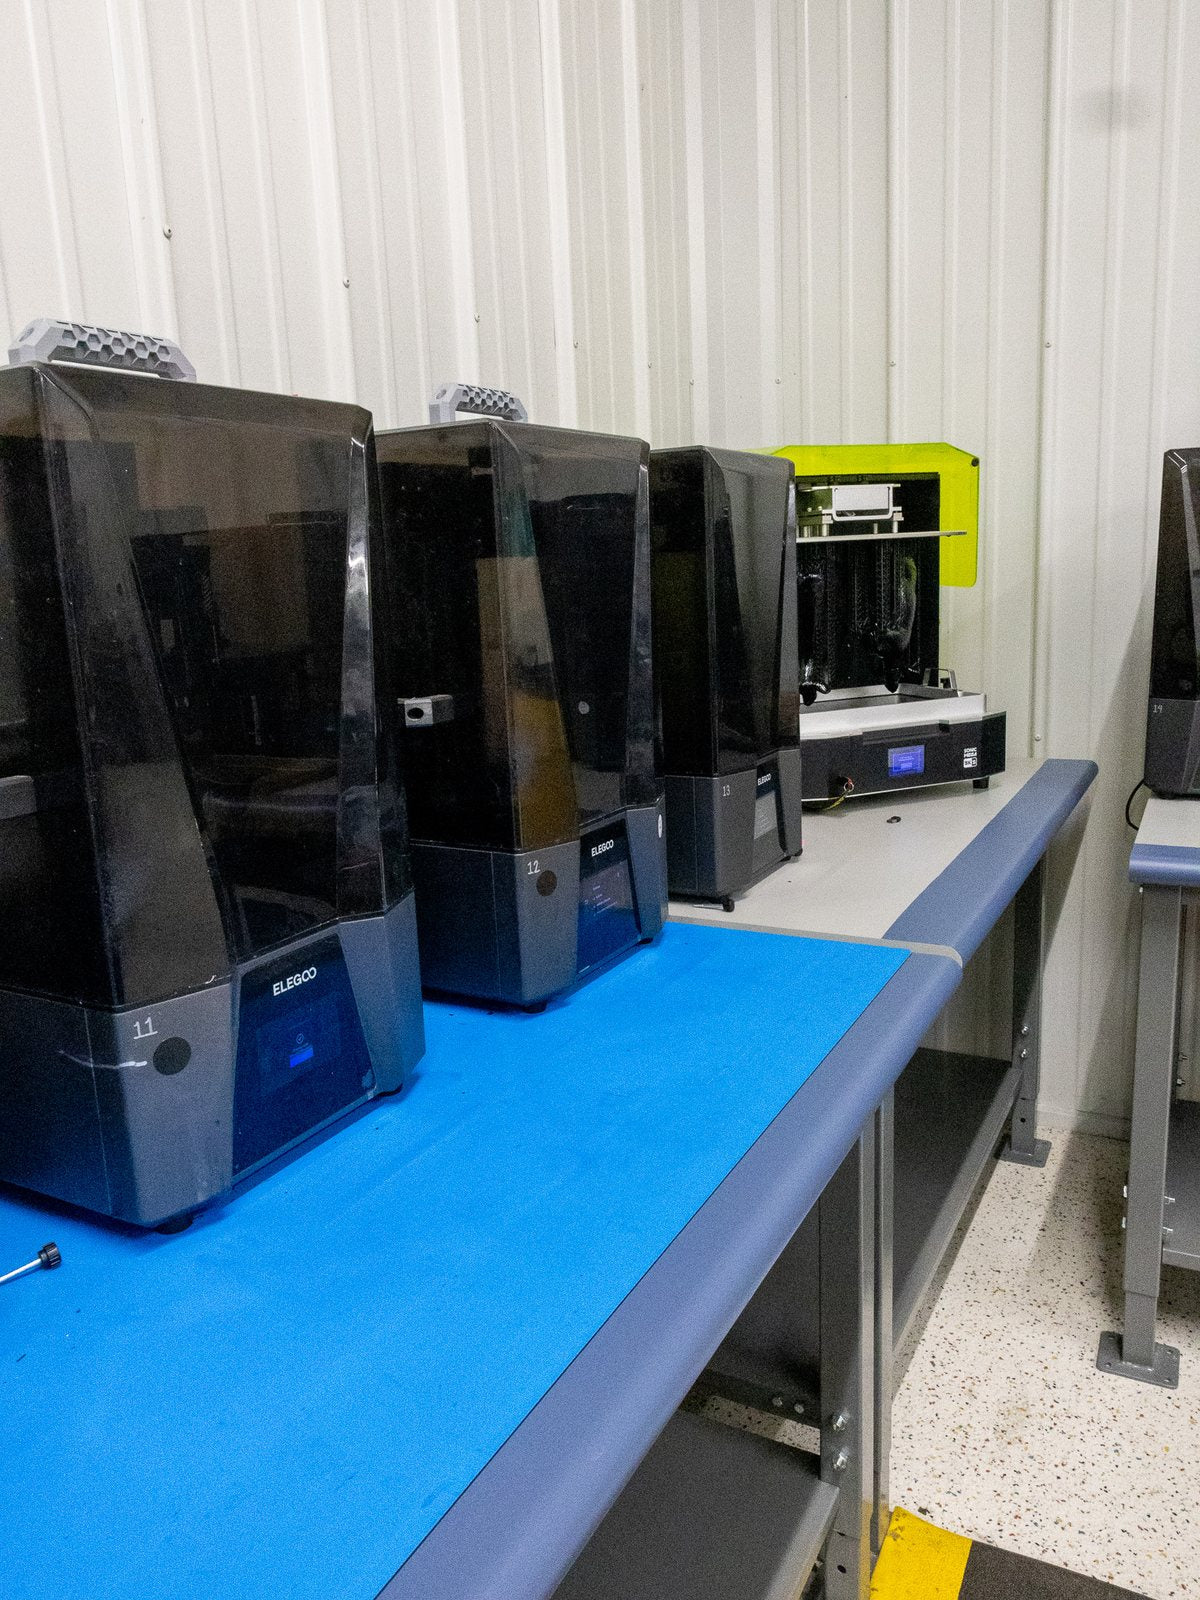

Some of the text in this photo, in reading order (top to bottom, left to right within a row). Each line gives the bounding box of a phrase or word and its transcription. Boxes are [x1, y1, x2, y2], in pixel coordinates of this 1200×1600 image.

[722, 784, 731, 797] 13
[591, 839, 614, 857] ELEGOO
[527, 860, 541, 875] 12
[272, 966, 317, 996] ELEGOO
[133, 1016, 158, 1040] 11
